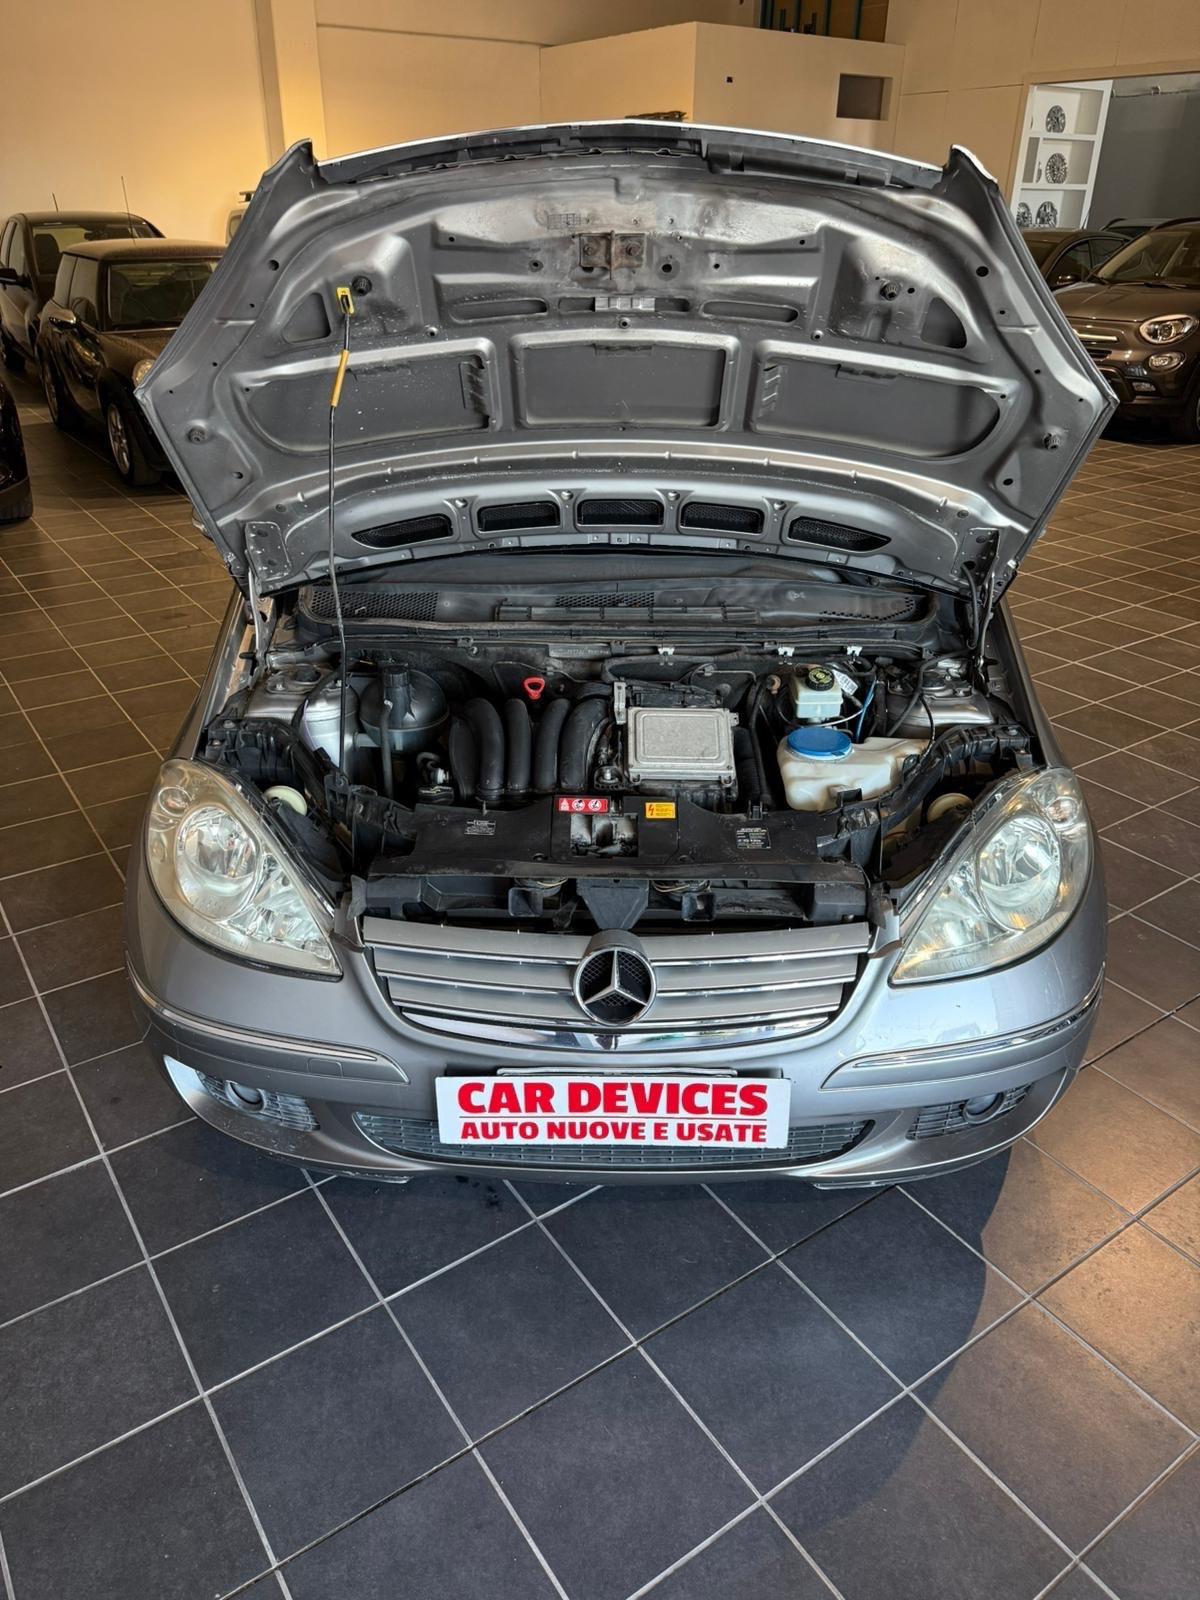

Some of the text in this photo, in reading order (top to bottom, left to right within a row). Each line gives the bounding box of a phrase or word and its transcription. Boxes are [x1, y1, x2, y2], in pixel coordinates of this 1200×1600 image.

[457, 1082, 768, 1116] CAR DEVICES
[461, 1121, 766, 1143] AUTO NUOVE E USATE
